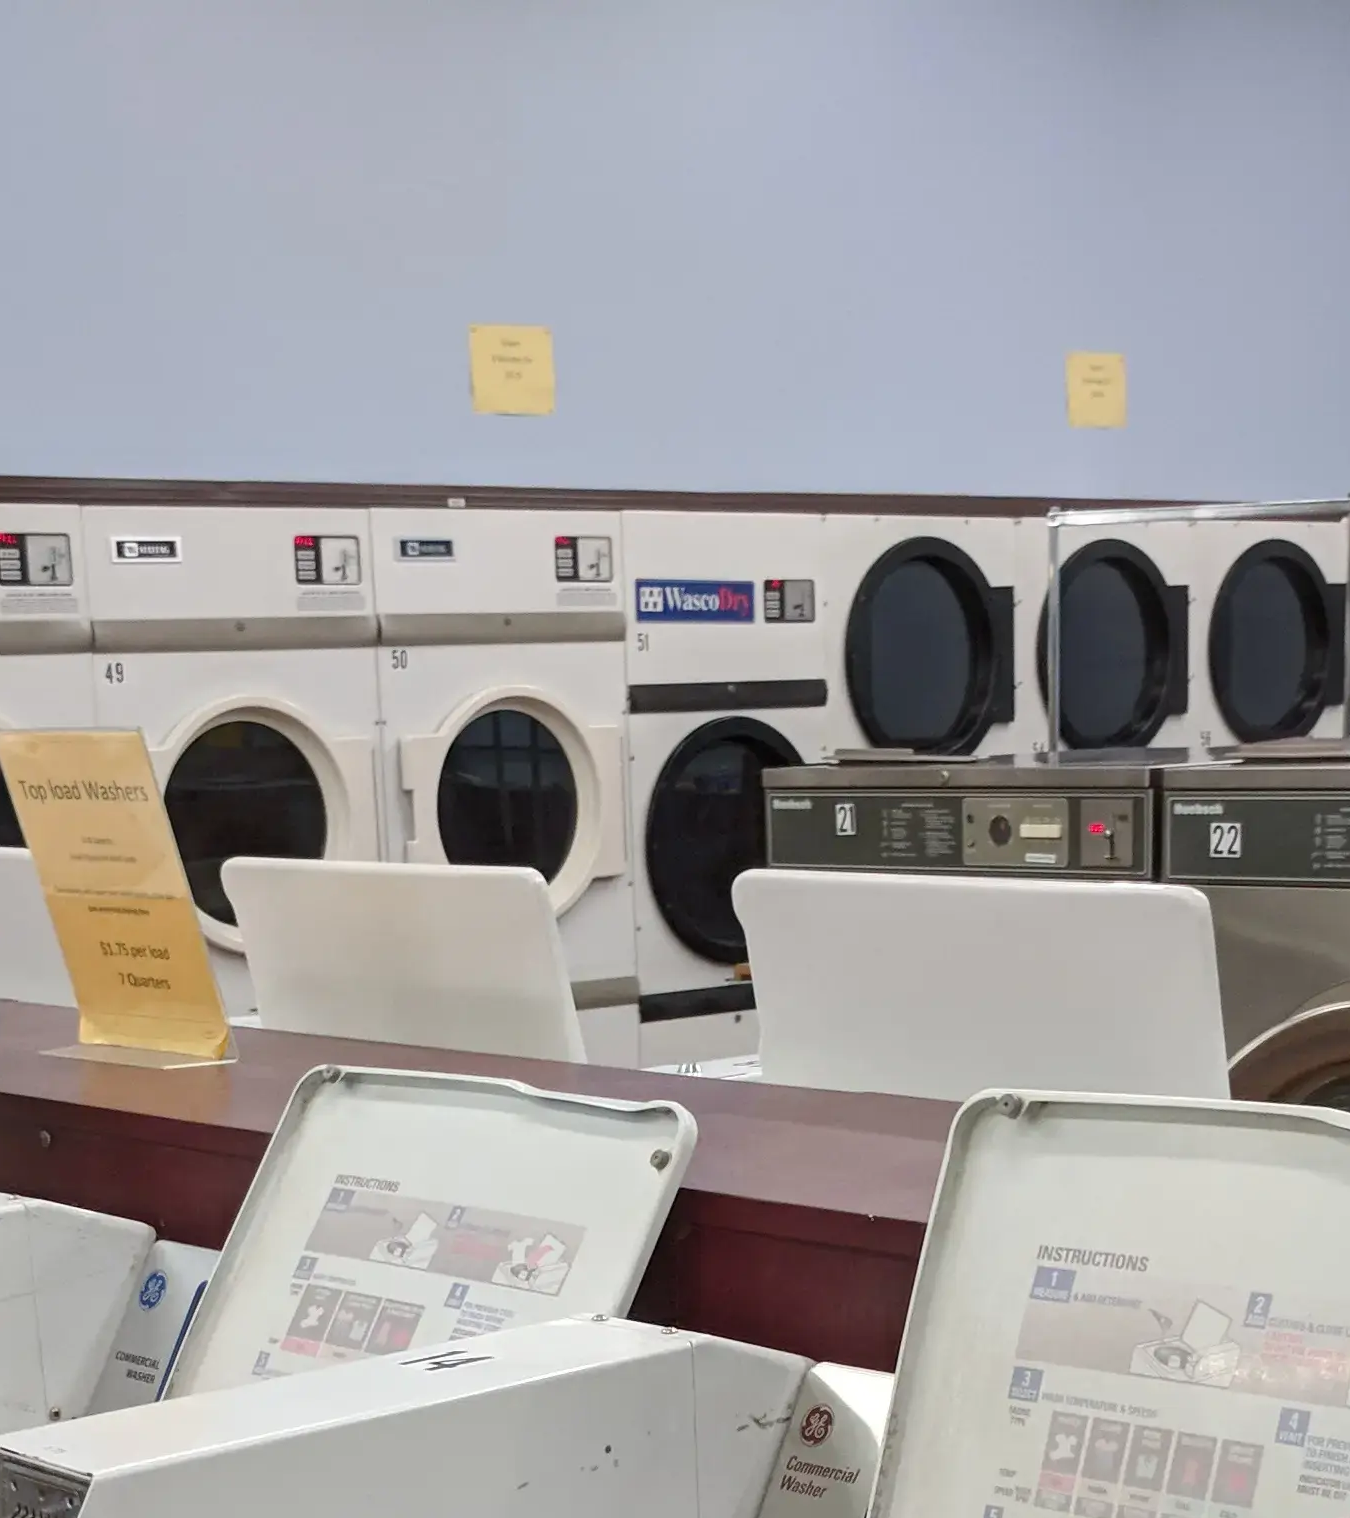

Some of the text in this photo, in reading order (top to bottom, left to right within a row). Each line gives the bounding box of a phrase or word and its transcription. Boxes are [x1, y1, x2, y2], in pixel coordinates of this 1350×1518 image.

[665, 586, 749, 617] WascoDry
[392, 650, 407, 669] 50
[105, 662, 124, 684] 49
[18, 780, 149, 804] Top load Washers
[838, 806, 854, 832] 21
[1212, 824, 1239, 856] 22
[100, 941, 170, 961] $1.75 per load
[118, 972, 171, 990] 7 Quarters
[334, 1174, 400, 1193] INSTRUCTIONS
[1036, 1245, 1149, 1273] INSTRUCTIONS
[1050, 1271, 1059, 1287] 1
[1254, 1297, 1265, 1313] 2
[115, 1350, 160, 1370] COMMERCIAL
[398, 1350, 494, 1371] 14
[126, 1369, 156, 1384] WASHER
[1022, 1370, 1031, 1386] 3
[1289, 1412, 1299, 1431] 4
[786, 1455, 861, 1484] Commercial
[780, 1475, 827, 1498] Washer
